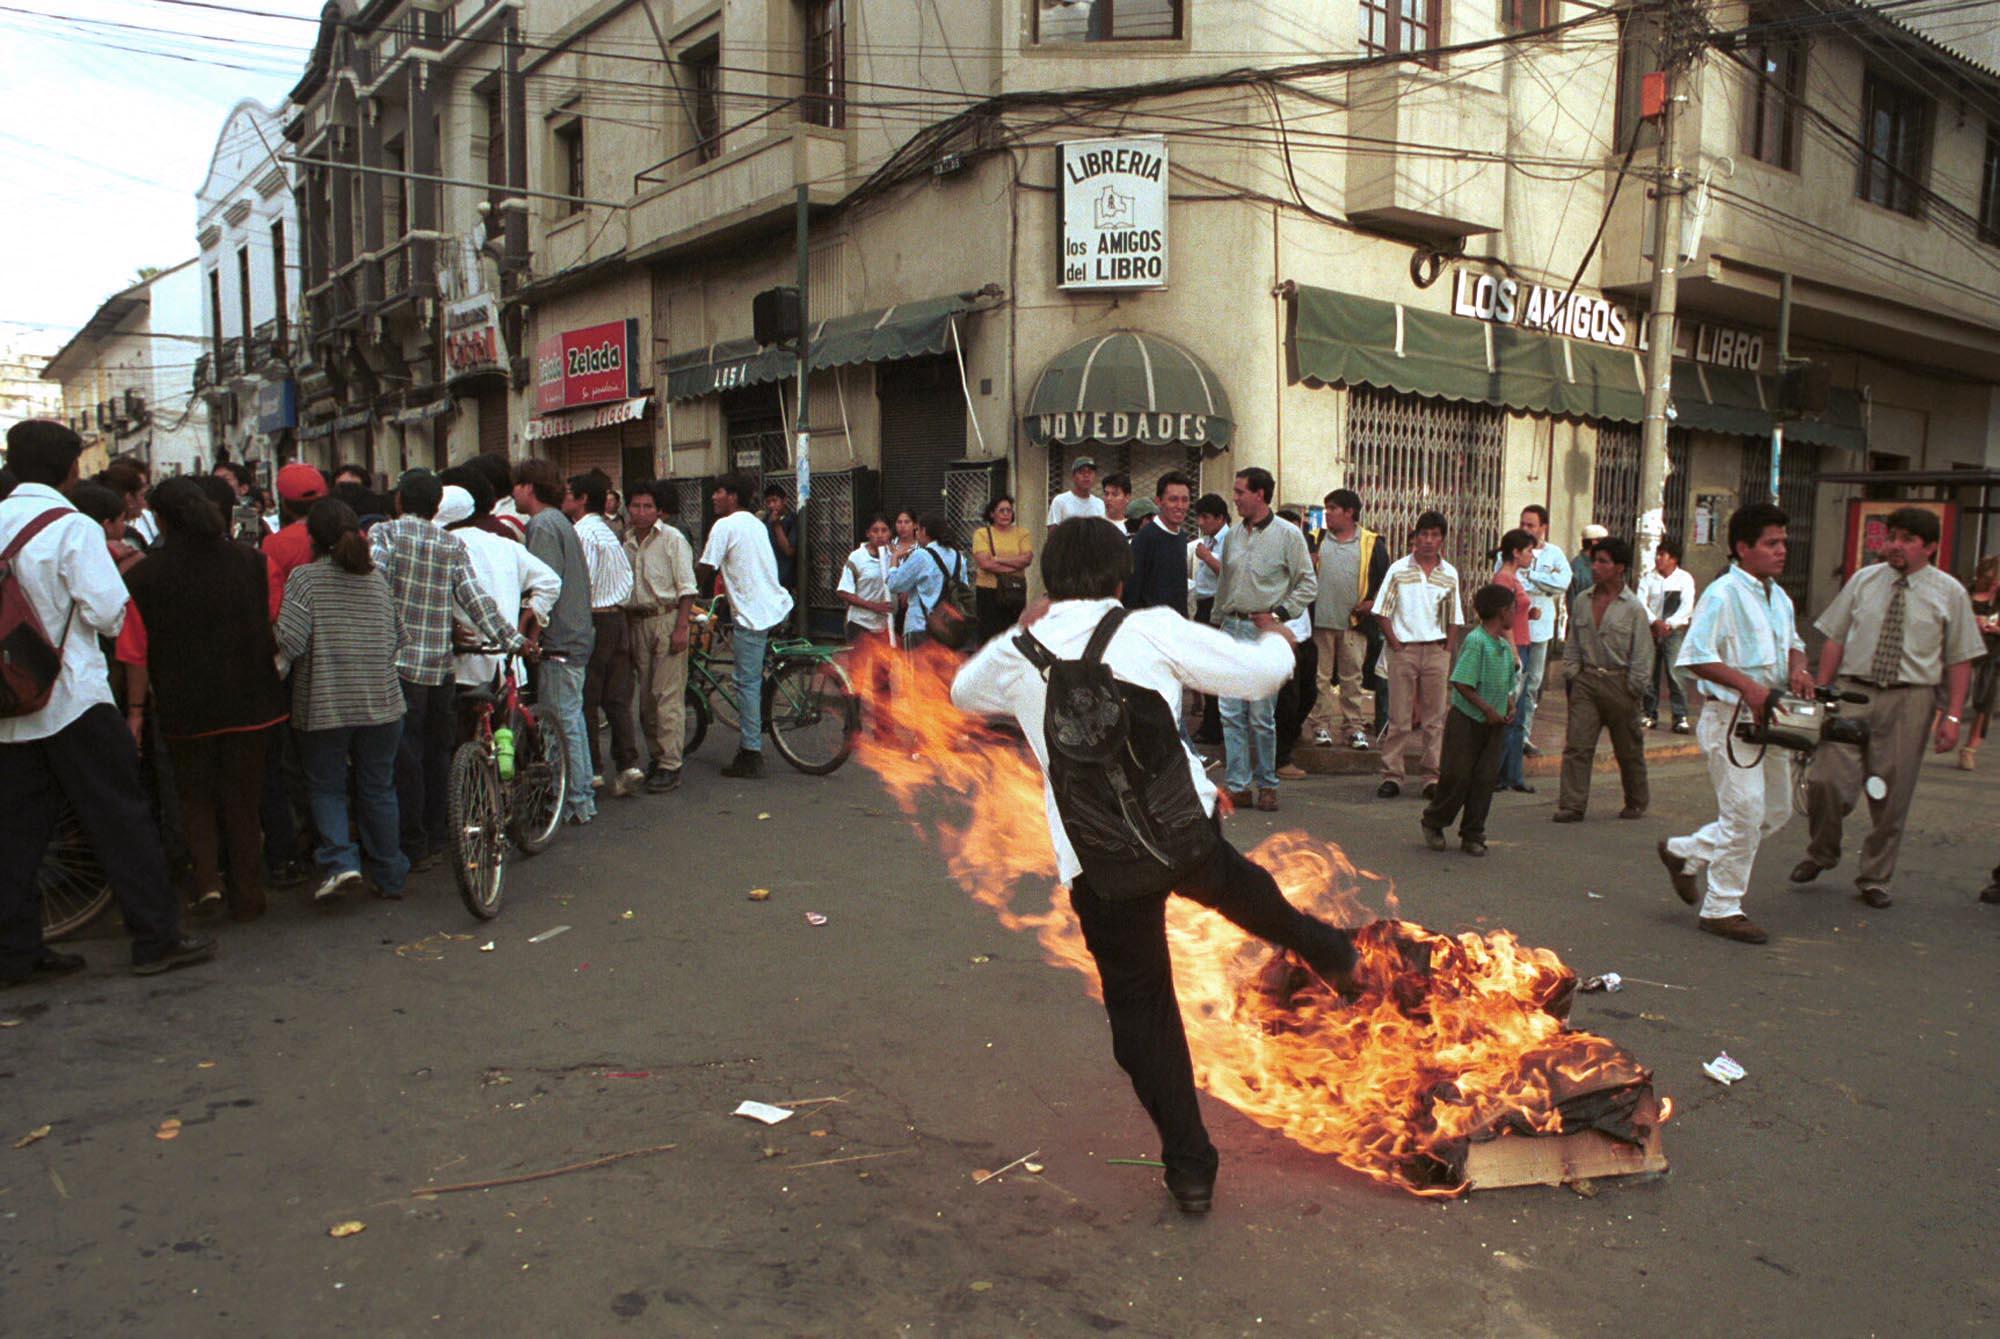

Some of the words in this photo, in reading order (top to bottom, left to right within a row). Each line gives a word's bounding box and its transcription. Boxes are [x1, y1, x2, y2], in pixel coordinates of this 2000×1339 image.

[1066, 149, 1162, 185] LIBRERIA
[1066, 237, 1087, 256] los
[1097, 229, 1162, 255] AMIGOS
[1066, 262, 1087, 282] del
[1096, 256, 1162, 281] LIBRO
[1455, 268, 1517, 323] LOS
[1524, 284, 1628, 346] AMIGOS
[1696, 322, 1763, 371] LIBRO
[567, 340, 622, 378] Zelada
[1040, 411, 1207, 441] NOVEDADES
